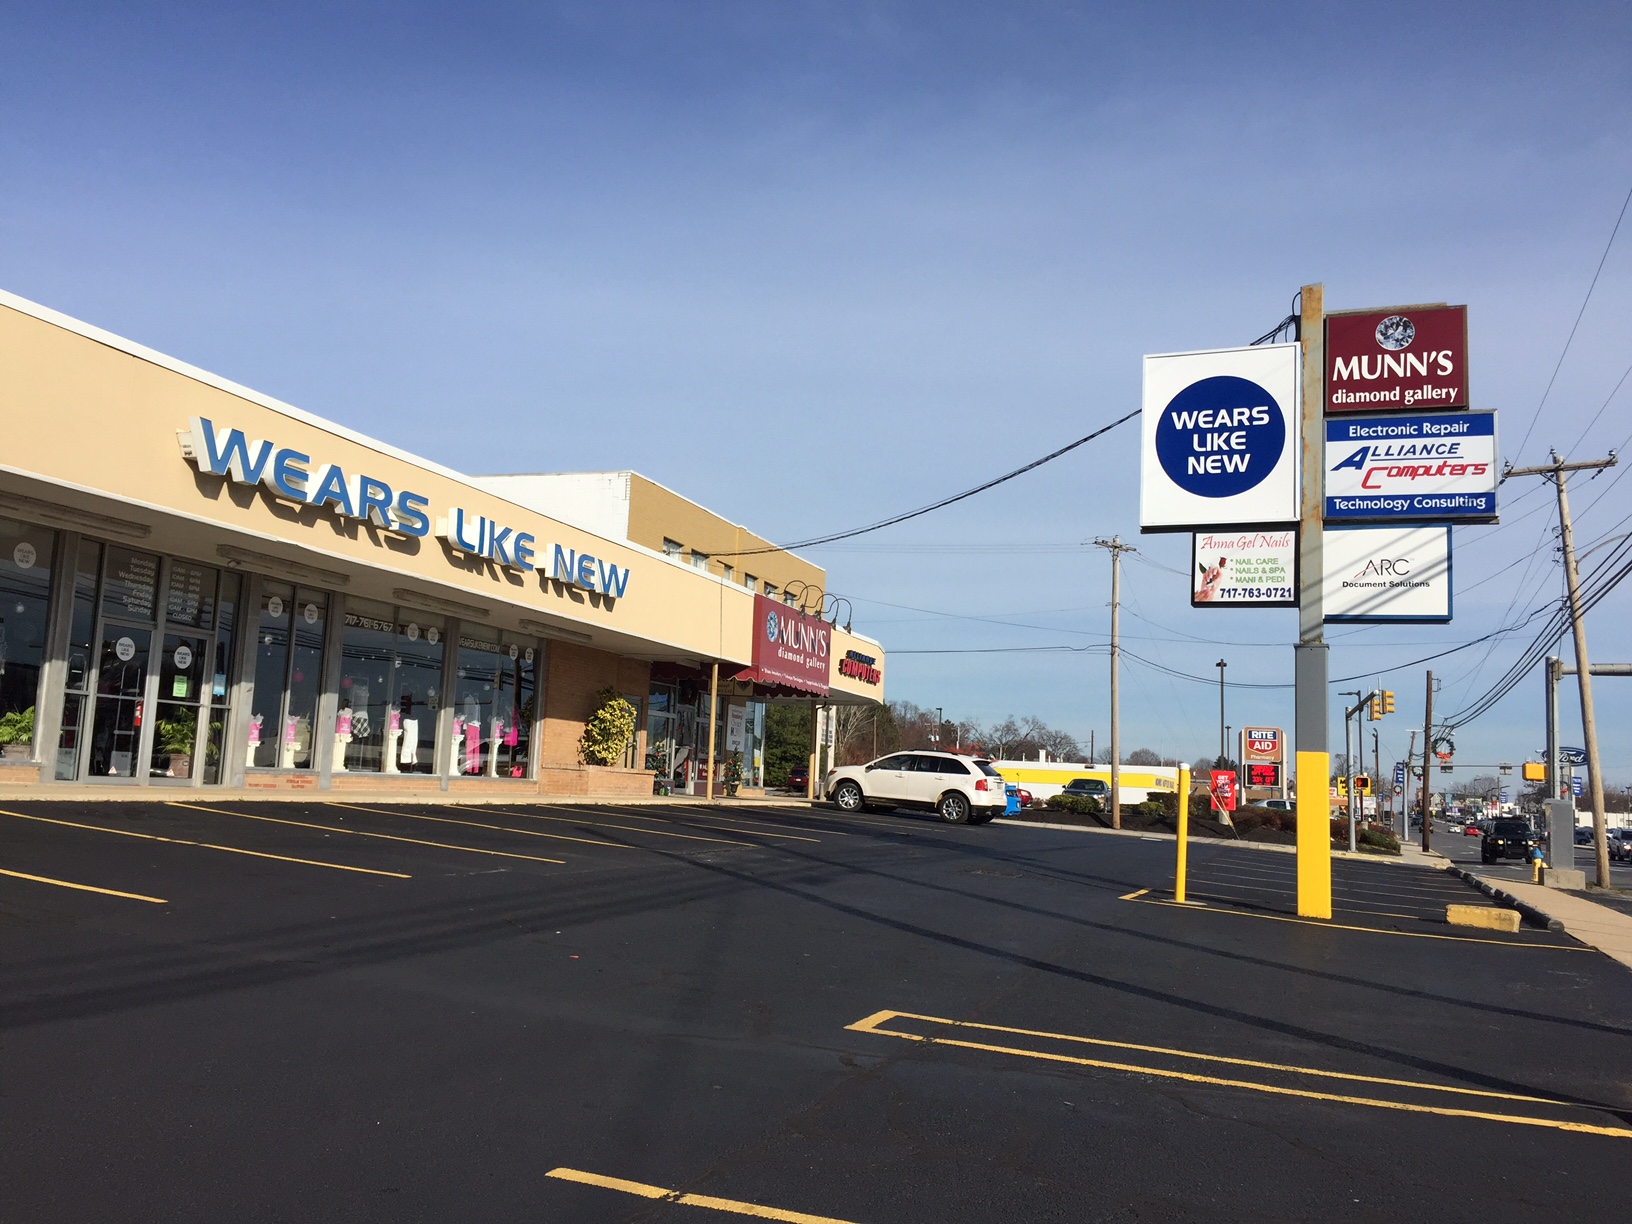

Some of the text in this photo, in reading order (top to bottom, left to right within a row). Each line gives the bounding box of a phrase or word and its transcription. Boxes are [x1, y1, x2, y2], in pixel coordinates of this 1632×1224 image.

[1332, 350, 1453, 381] MUNN'S
[1332, 385, 1458, 405] diamond gallery
[1171, 406, 1270, 430] WEARS
[1349, 421, 1470, 437] Electronic Repair
[1193, 431, 1246, 452] LIKE
[1188, 454, 1251, 474] NEW
[1330, 443, 1460, 471] ALLIANCE
[199, 416, 630, 599] WEARS LIKE NEW
[1334, 496, 1486, 510] Technology Consulting
[1200, 532, 1290, 550] Anna Gel Nails
[130, 565, 155, 576] Tuesday
[132, 558, 156, 568] Monday
[1361, 558, 1410, 576] ARC
[118, 571, 154, 584] Wednesday
[124, 580, 153, 591] Thursday
[123, 596, 152, 607] Saturday
[1220, 587, 1292, 598] 717-763-0721
[128, 605, 151, 615] Sunday
[344, 614, 394, 632] 717-761-6767
[779, 616, 826, 657] MUNN'S
[778, 646, 826, 673] diamond gallery
[842, 660, 881, 683] COMPUTERS
[1252, 731, 1274, 739] RITE
[1253, 742, 1272, 750] AID
